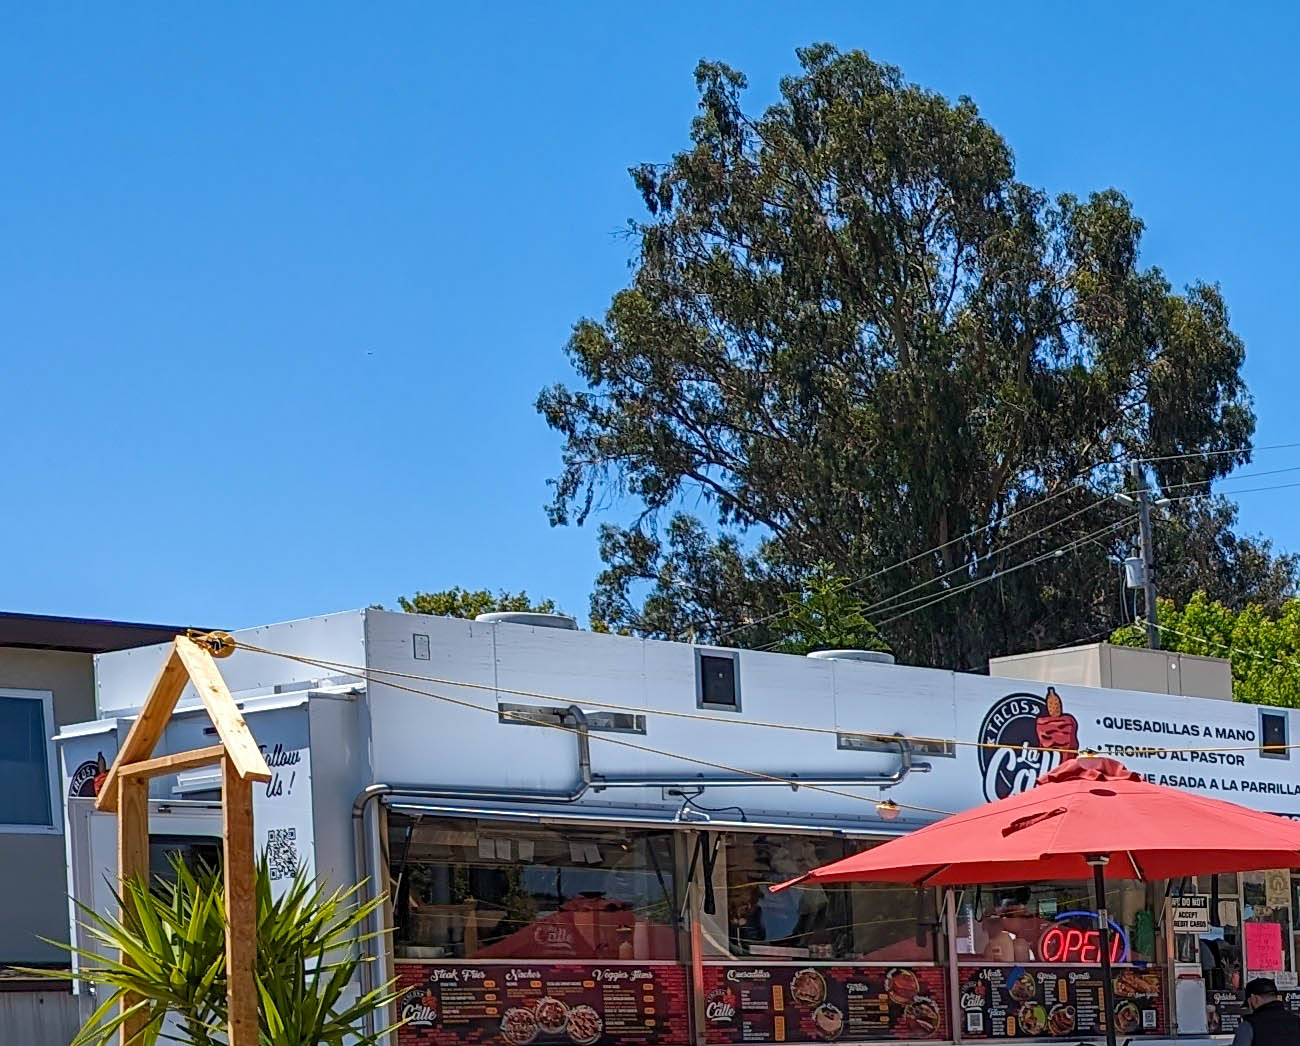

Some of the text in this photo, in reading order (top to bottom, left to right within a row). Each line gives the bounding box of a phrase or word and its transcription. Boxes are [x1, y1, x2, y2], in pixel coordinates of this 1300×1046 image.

[987, 700, 1029, 734] TACOS
[1103, 717, 1256, 742] QUESADILLAS A MANO
[1104, 744, 1245, 767] TROMPO AL PASTOR
[266, 772, 282, 798] Us
[1159, 774, 1207, 790] ASADA
[1209, 778, 1220, 790] A
[1222, 779, 1239, 792] LA
[1178, 911, 1198, 919] ACCEPT
[431, 969, 460, 981] Steak
[505, 969, 541, 981] Nachos
[591, 969, 628, 982] Veggies
[401, 1004, 437, 1022] Calle
[706, 1001, 736, 1019] Calle
